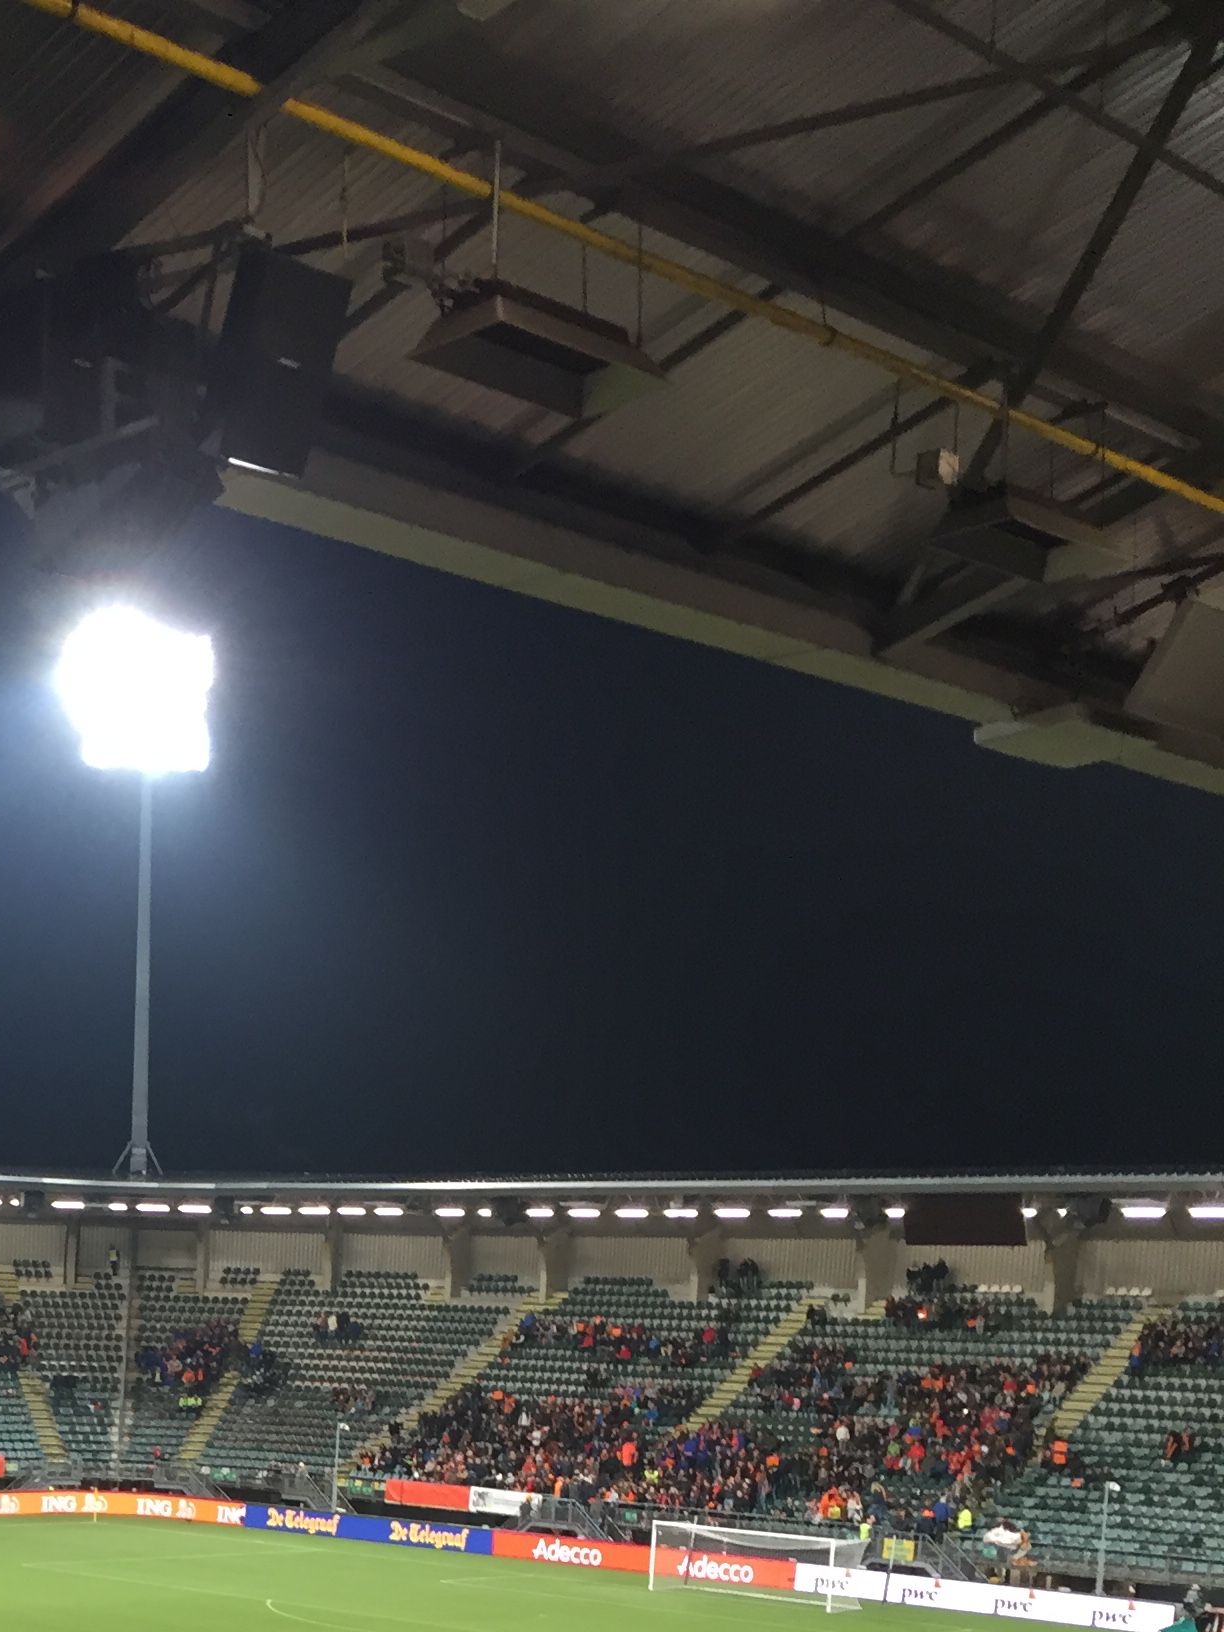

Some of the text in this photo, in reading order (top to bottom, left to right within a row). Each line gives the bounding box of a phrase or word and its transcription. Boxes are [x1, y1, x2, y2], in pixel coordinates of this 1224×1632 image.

[41, 1496, 76, 1512] ING
[137, 1498, 172, 1517] ING
[266, 1507, 340, 1536] De Telegraaf
[389, 1520, 470, 1551] De Telegraaf
[532, 1538, 602, 1566] Adecco
[677, 1554, 753, 1583] Adecco
[902, 1588, 938, 1603] pwc
[994, 1598, 1033, 1614] pwc
[1092, 1610, 1132, 1627] pwc
